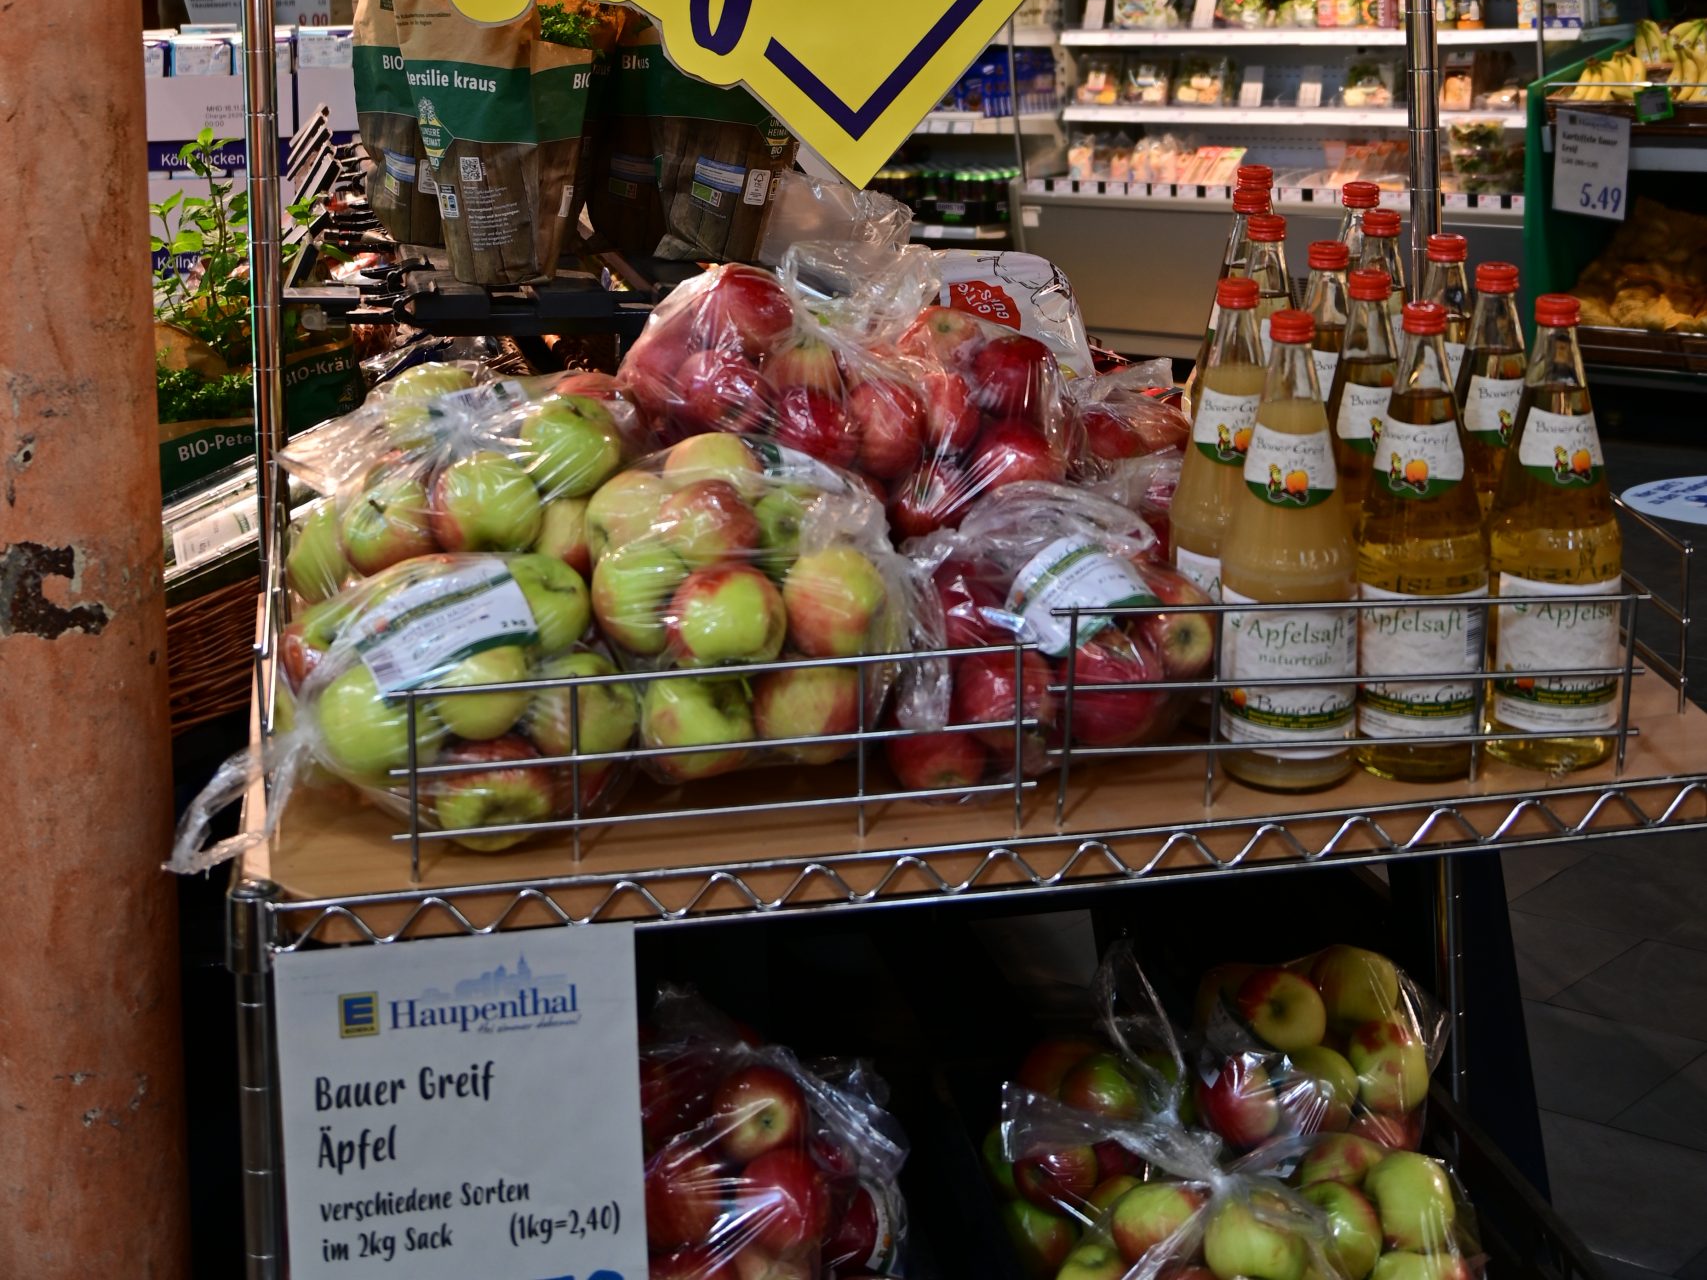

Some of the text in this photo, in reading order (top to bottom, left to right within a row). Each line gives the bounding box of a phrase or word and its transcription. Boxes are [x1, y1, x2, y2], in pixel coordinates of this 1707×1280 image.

[454, 70, 497, 93] kraus
[161, 152, 245, 167] Köllflocken
[1580, 182, 1622, 214] 5.49
[1248, 618, 1346, 650] Apfelsaft
[1365, 608, 1464, 640] Apfelsaft
[1258, 652, 1333, 668] naturtrüb
[388, 983, 581, 1033] Haupenthal
[315, 1060, 496, 1111] Bauer Greif
[317, 1124, 398, 1175] Äpfel
[320, 1177, 531, 1222] verschiedene Sorten
[322, 1200, 622, 1263] im 2kg Sack (1kg=2,40)
